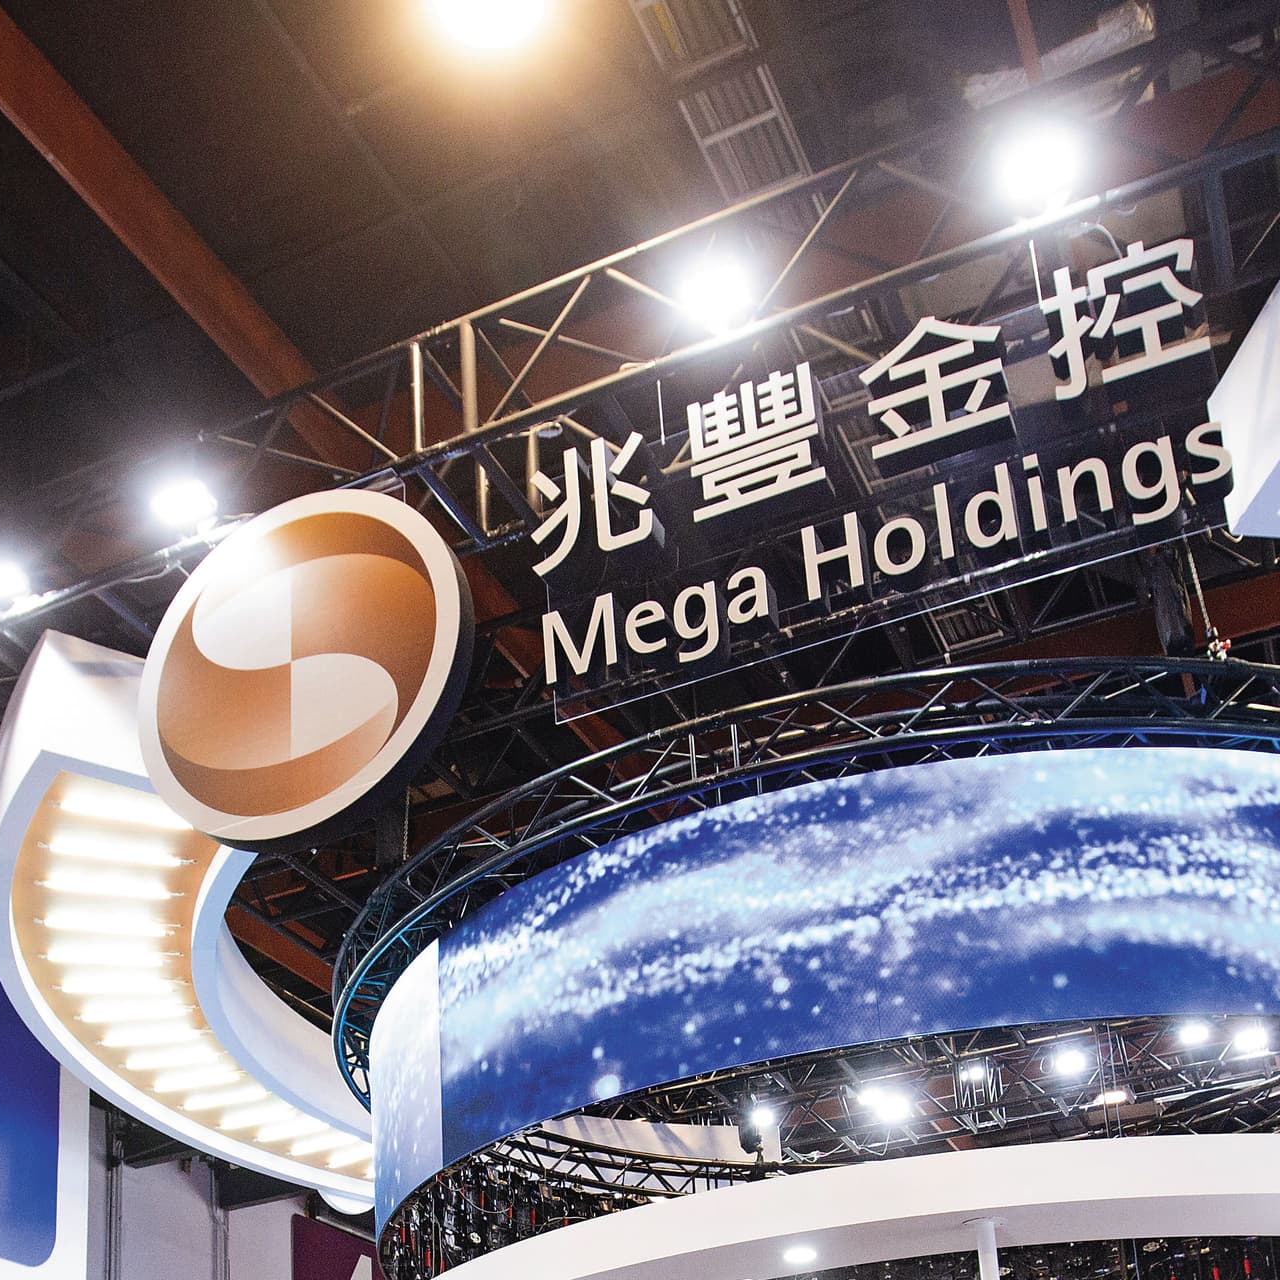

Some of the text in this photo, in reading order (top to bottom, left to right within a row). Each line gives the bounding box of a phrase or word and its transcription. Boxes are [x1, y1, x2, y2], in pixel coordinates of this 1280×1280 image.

[530, 238, 1212, 579] 兆豐金控
[542, 421, 1233, 686] Mega Holdings
